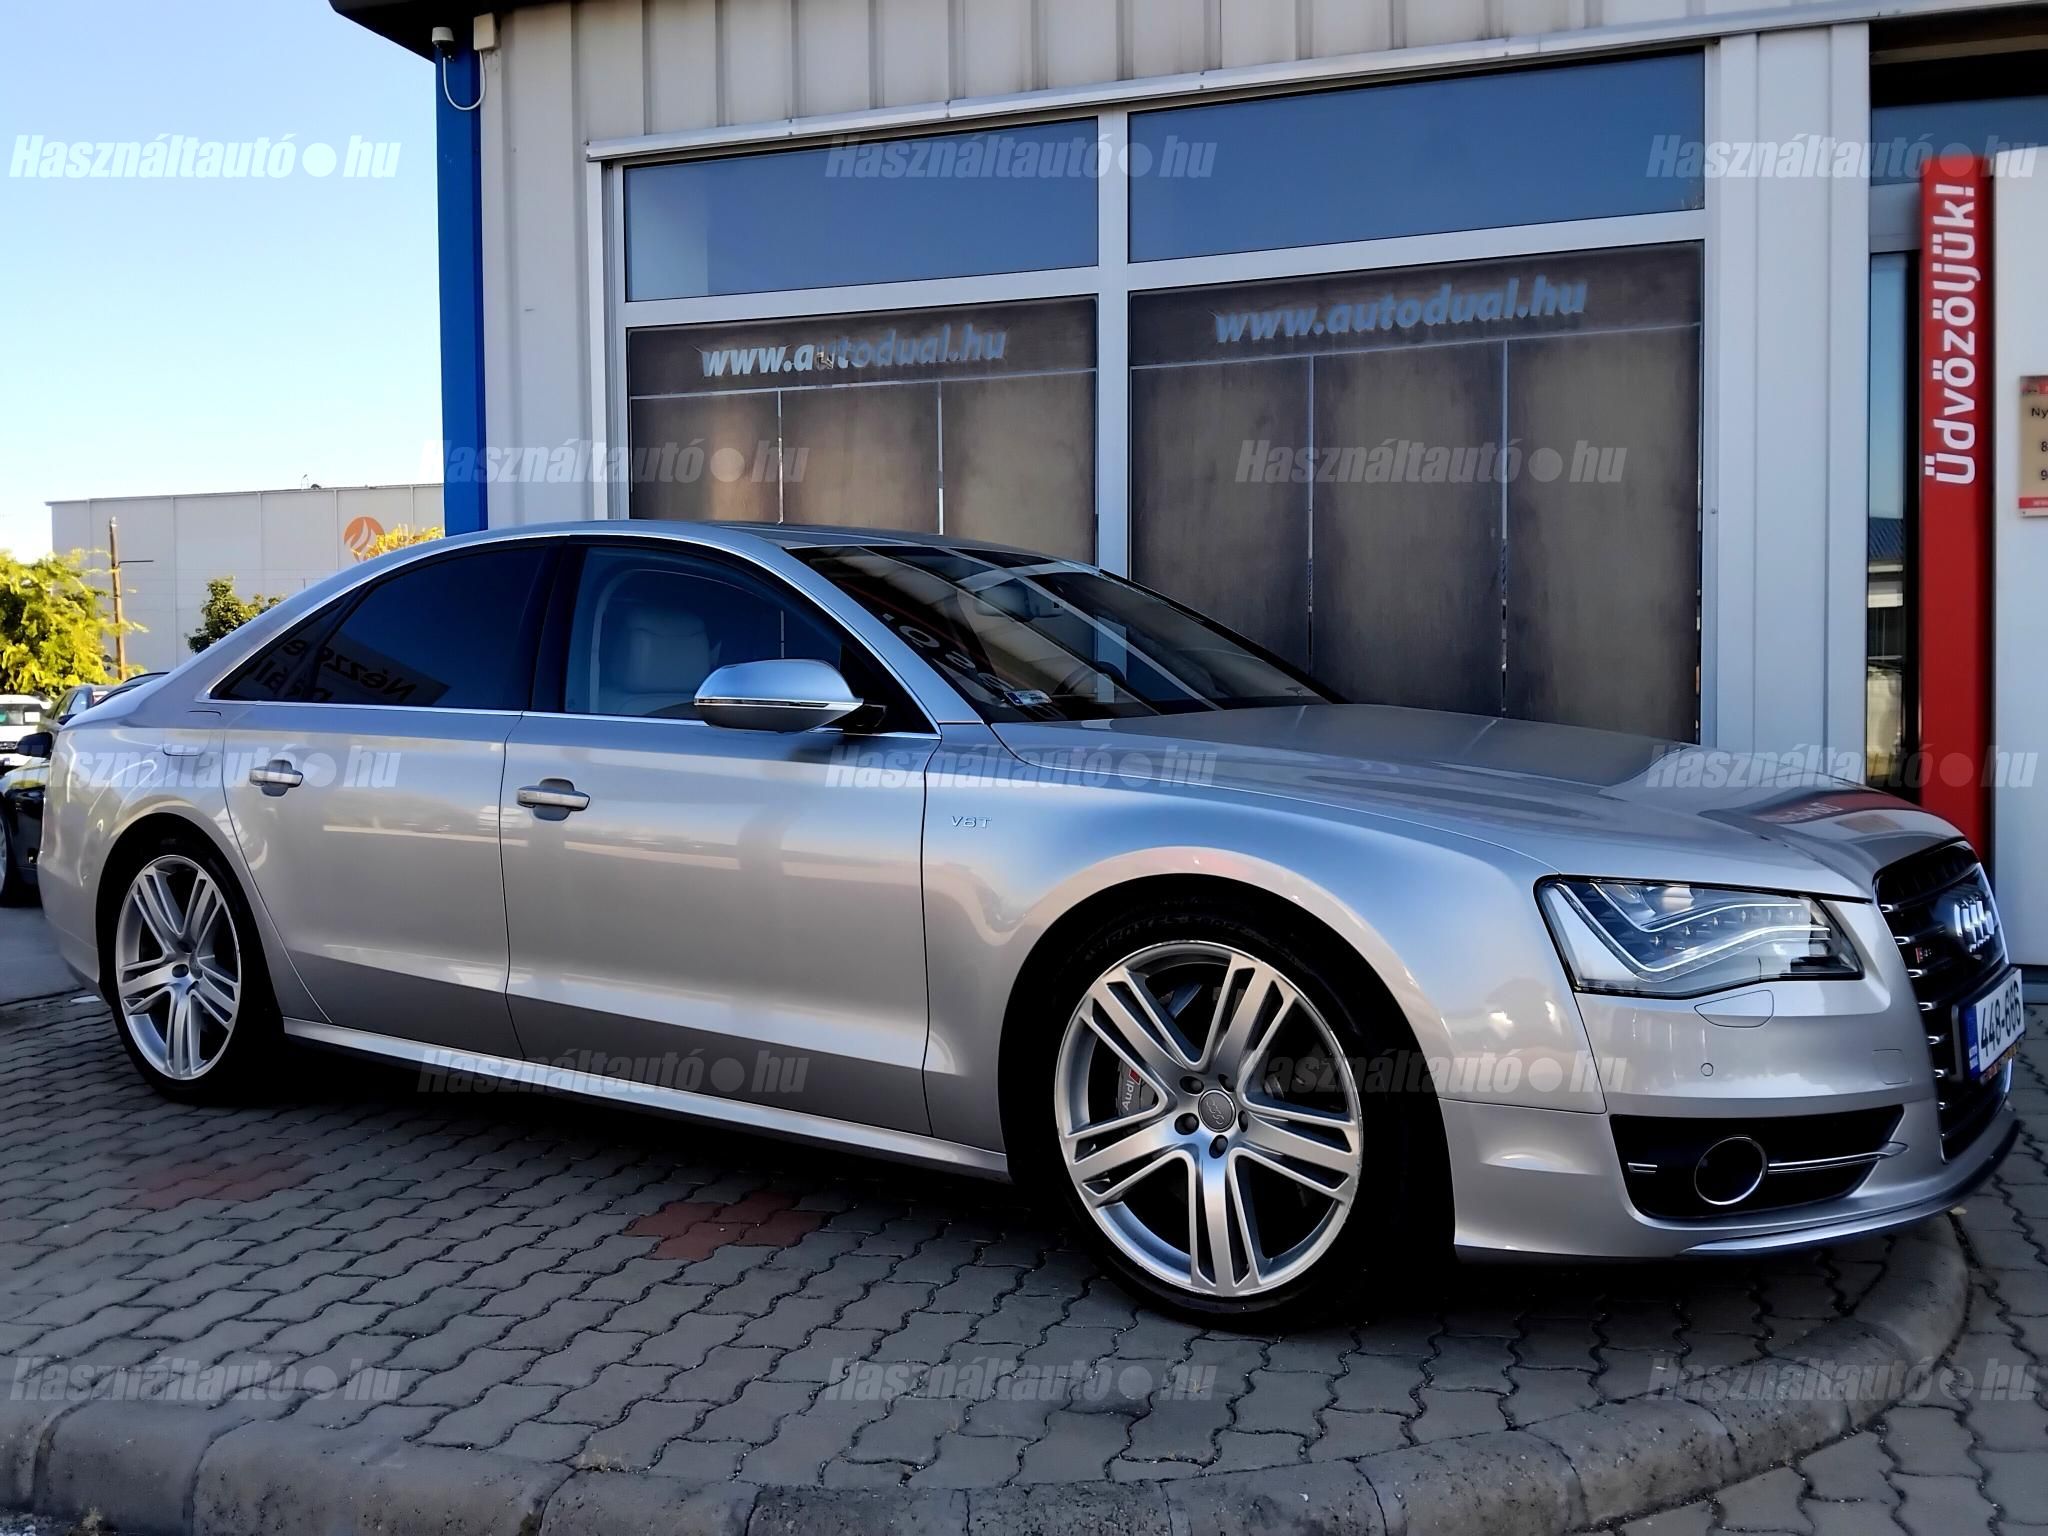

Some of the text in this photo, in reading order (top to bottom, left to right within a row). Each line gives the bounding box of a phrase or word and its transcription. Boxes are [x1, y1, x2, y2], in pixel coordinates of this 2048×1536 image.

[1215, 274, 1588, 343] www.autodual.hu
[1925, 183, 1981, 484] Üdvözöljük!
[702, 323, 1007, 377] www.autodual.hu
[1123, 1081, 1135, 1111] Audi
